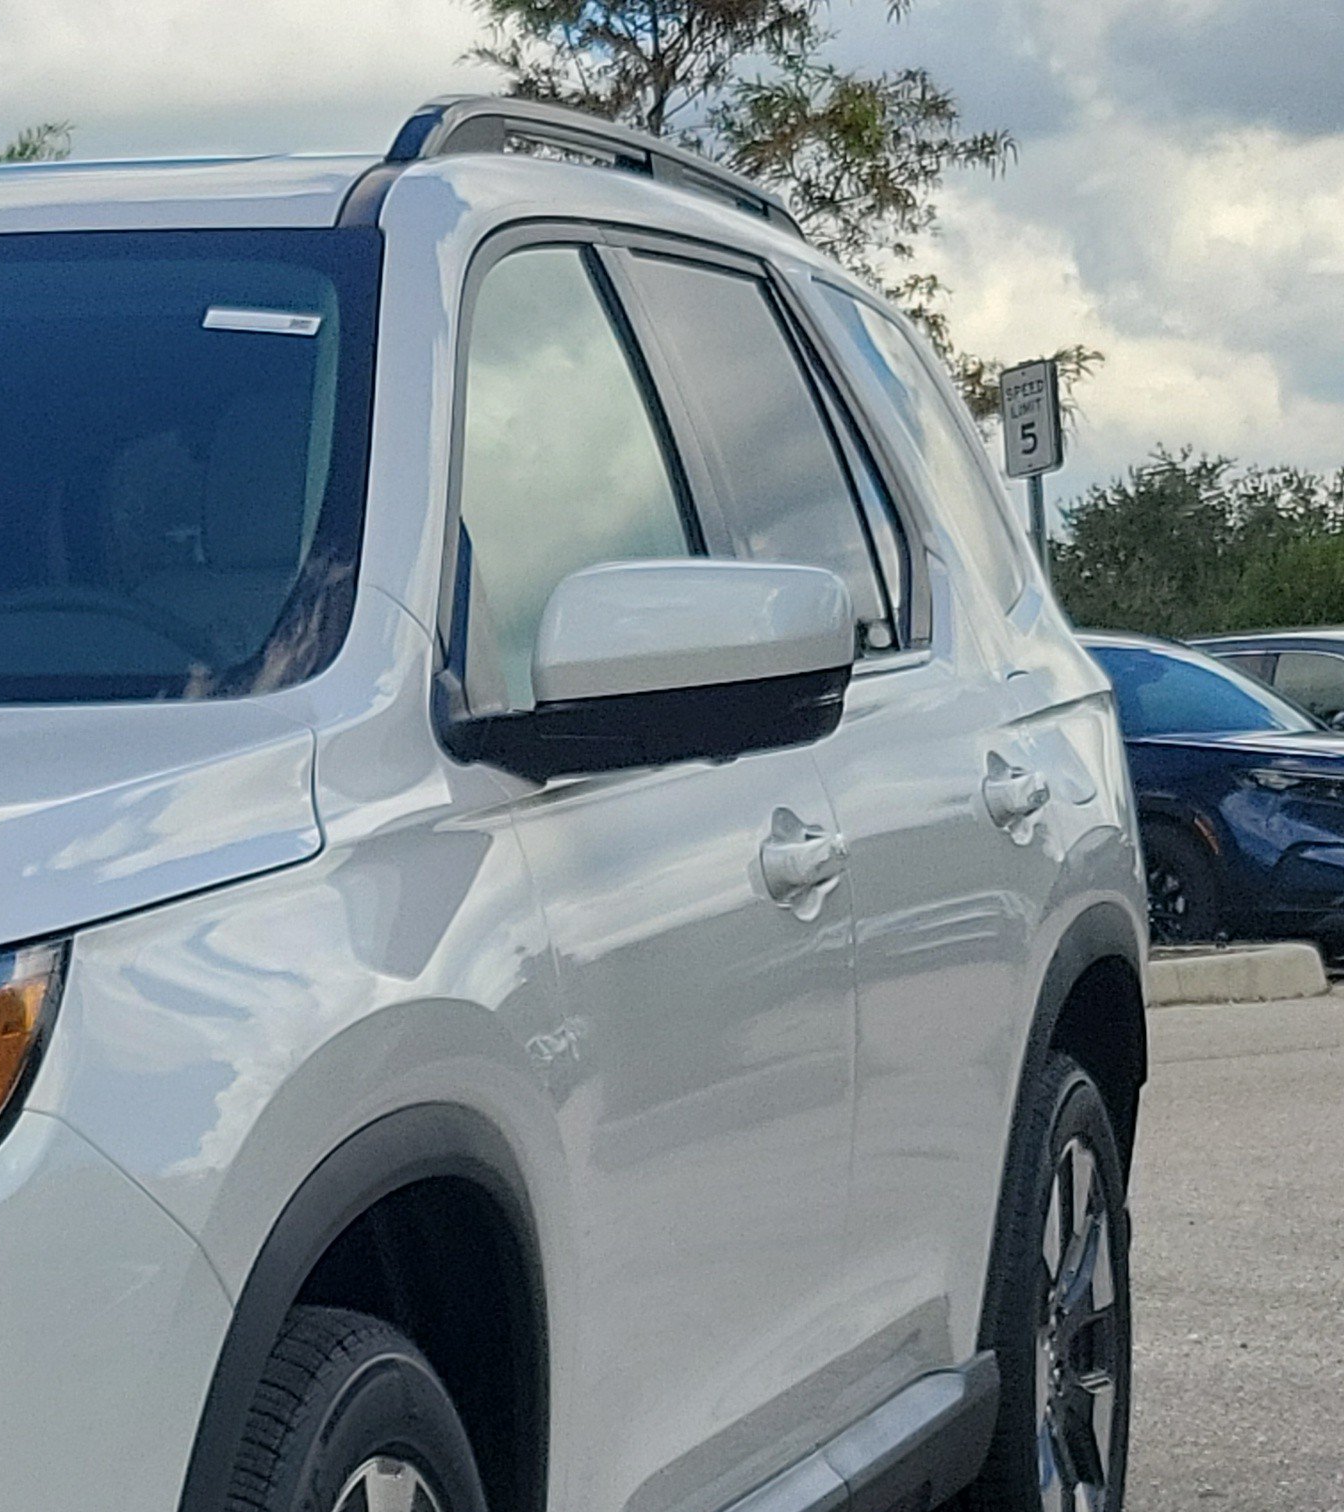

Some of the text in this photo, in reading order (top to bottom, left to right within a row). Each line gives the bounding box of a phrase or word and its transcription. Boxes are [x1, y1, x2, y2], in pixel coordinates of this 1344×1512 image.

[1005, 379, 1045, 402] SPEED
[1010, 397, 1042, 419] LIMIT
[1020, 421, 1039, 455] 5
